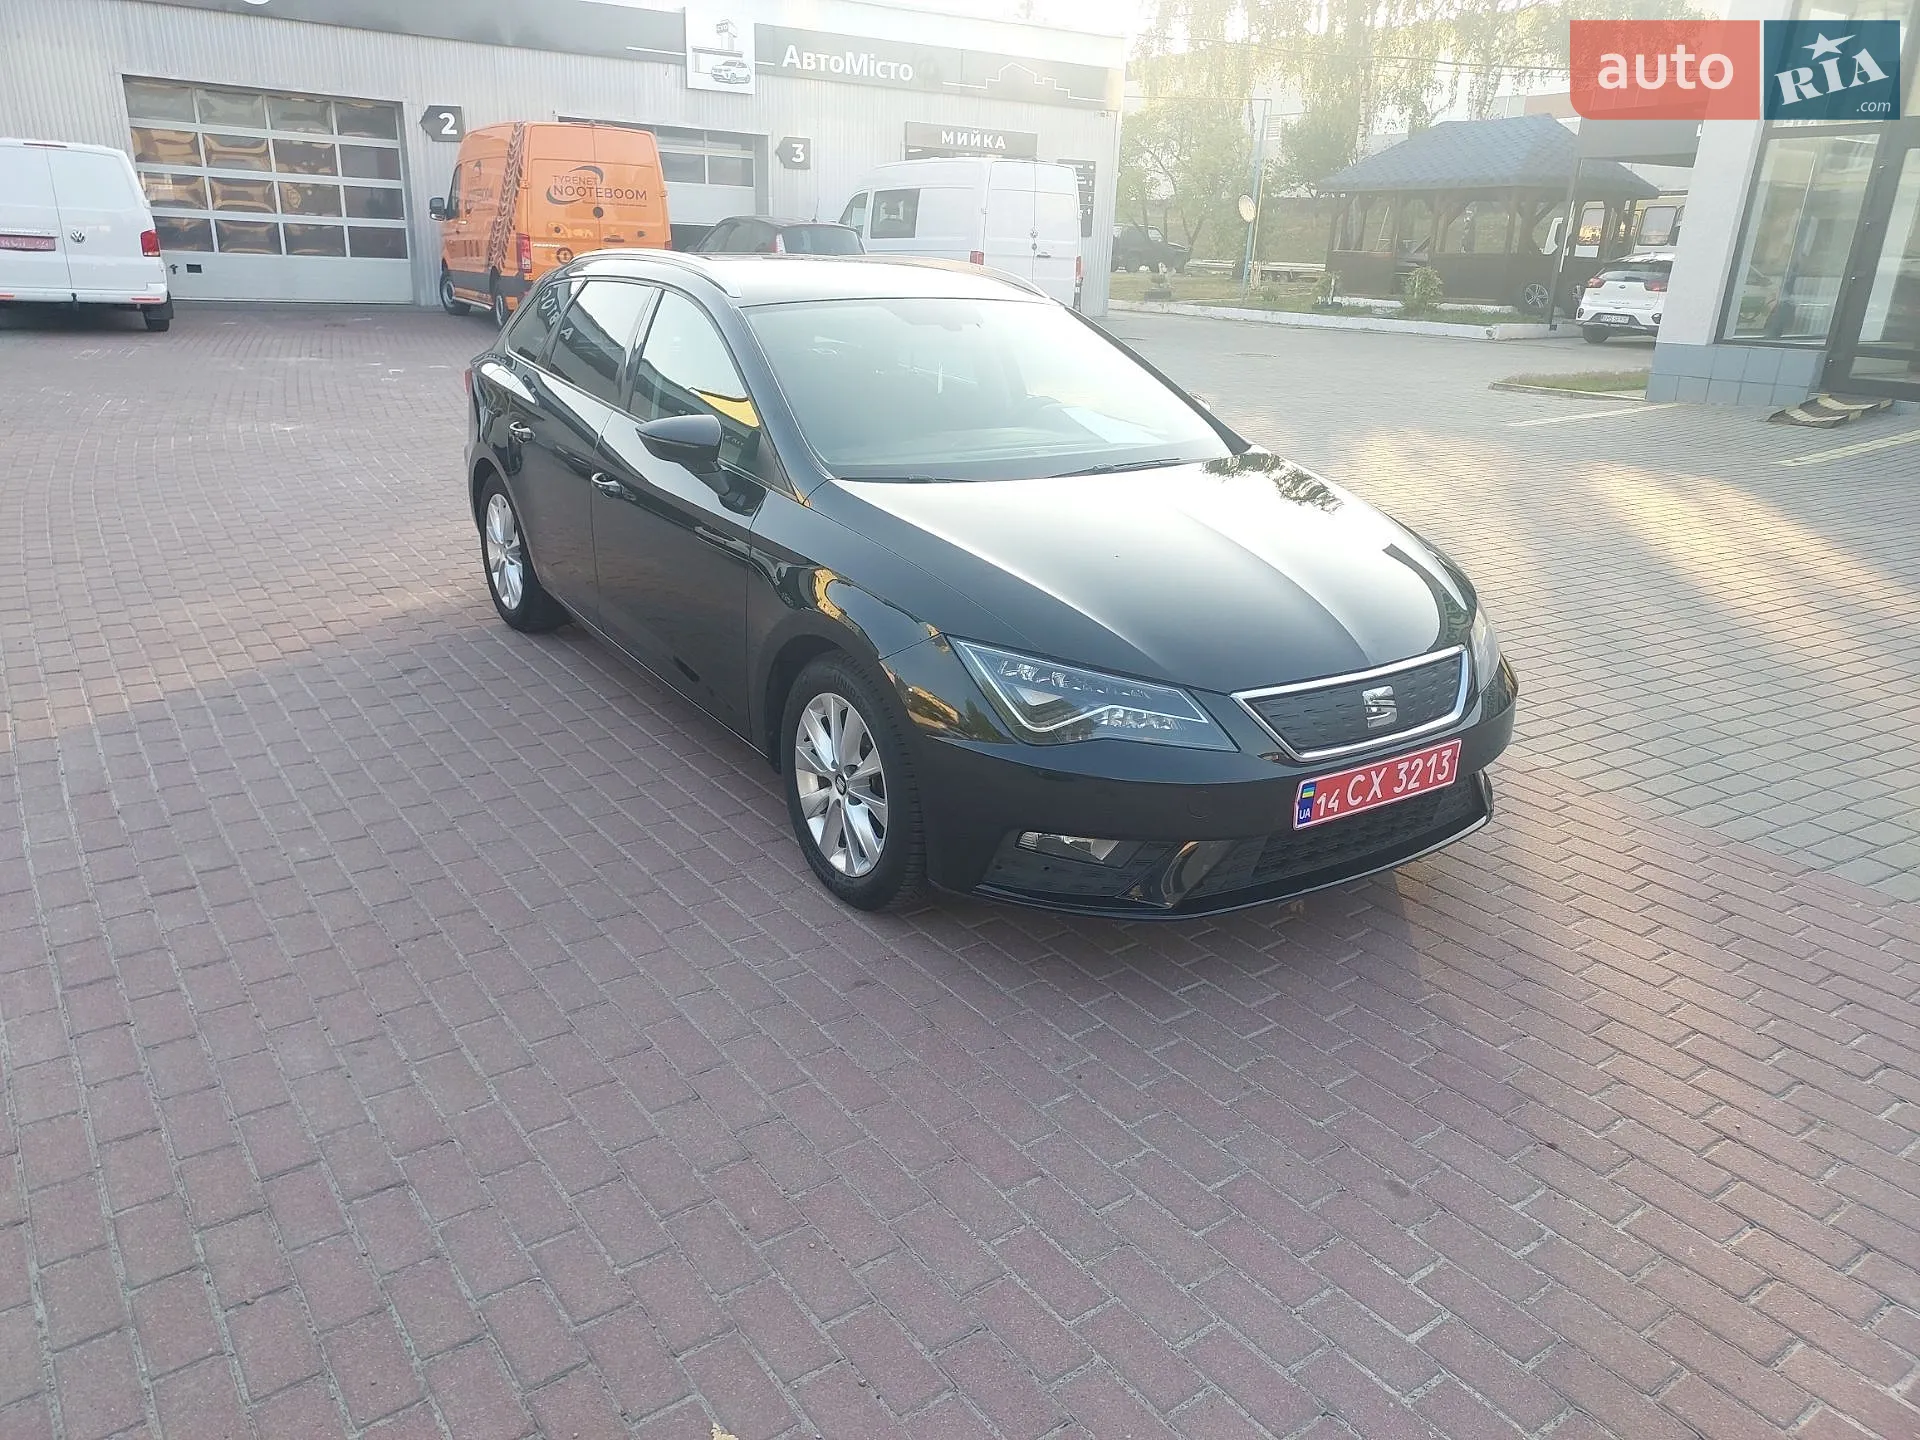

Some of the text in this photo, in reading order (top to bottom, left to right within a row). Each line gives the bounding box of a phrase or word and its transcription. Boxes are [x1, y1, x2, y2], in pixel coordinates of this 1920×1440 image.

[782, 44, 914, 82] АвтоМісто
[439, 113, 458, 135] 2
[940, 130, 1006, 150] МИЙКА
[791, 143, 806, 163] 3
[553, 185, 648, 201] NOOTEBOOM
[1316, 749, 1453, 817] 14 CX 3213
[1299, 809, 1311, 820] UA
